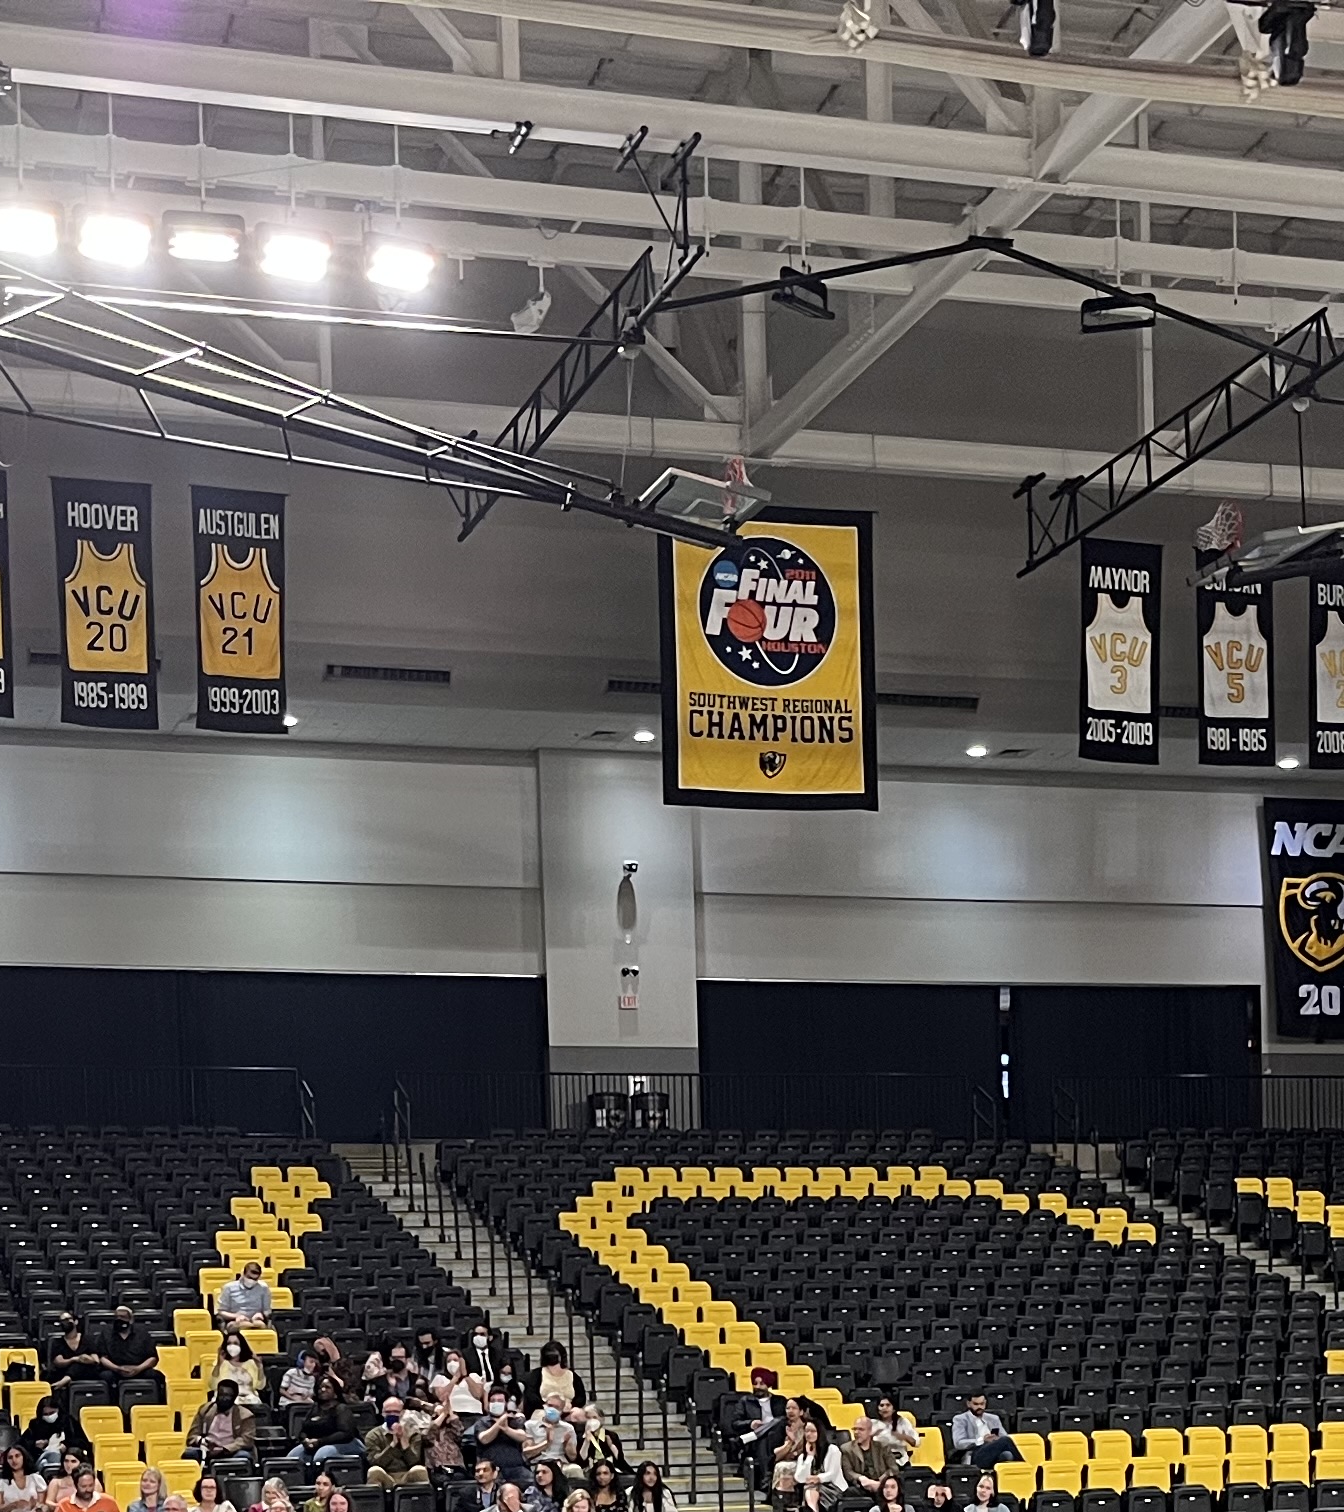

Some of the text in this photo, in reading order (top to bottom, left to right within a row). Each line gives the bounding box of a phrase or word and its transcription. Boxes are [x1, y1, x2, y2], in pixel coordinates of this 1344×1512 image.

[67, 501, 139, 532] HOOVER
[198, 507, 280, 540] AUSTGULEN
[737, 568, 819, 605] FINAL
[785, 568, 817, 580] 2011
[1089, 565, 1150, 593] MAYNOR
[71, 585, 141, 623] VCU
[208, 591, 273, 625] VCU
[85, 621, 128, 653] 20
[221, 626, 254, 656] 21
[761, 640, 827, 655] HOUSTON
[1090, 632, 1148, 667] VCU
[1205, 640, 1263, 672] VCU
[72, 680, 148, 709] 1985-1989
[1110, 665, 1128, 694] 3
[1226, 672, 1245, 703] 5
[207, 686, 280, 715] 1999-2003
[688, 692, 852, 714] SOUTHWEST REGIONAL
[688, 709, 854, 743] CHAMPIONS
[1085, 717, 1153, 745] 2005-2009
[1207, 727, 1267, 751] 1981-1985
